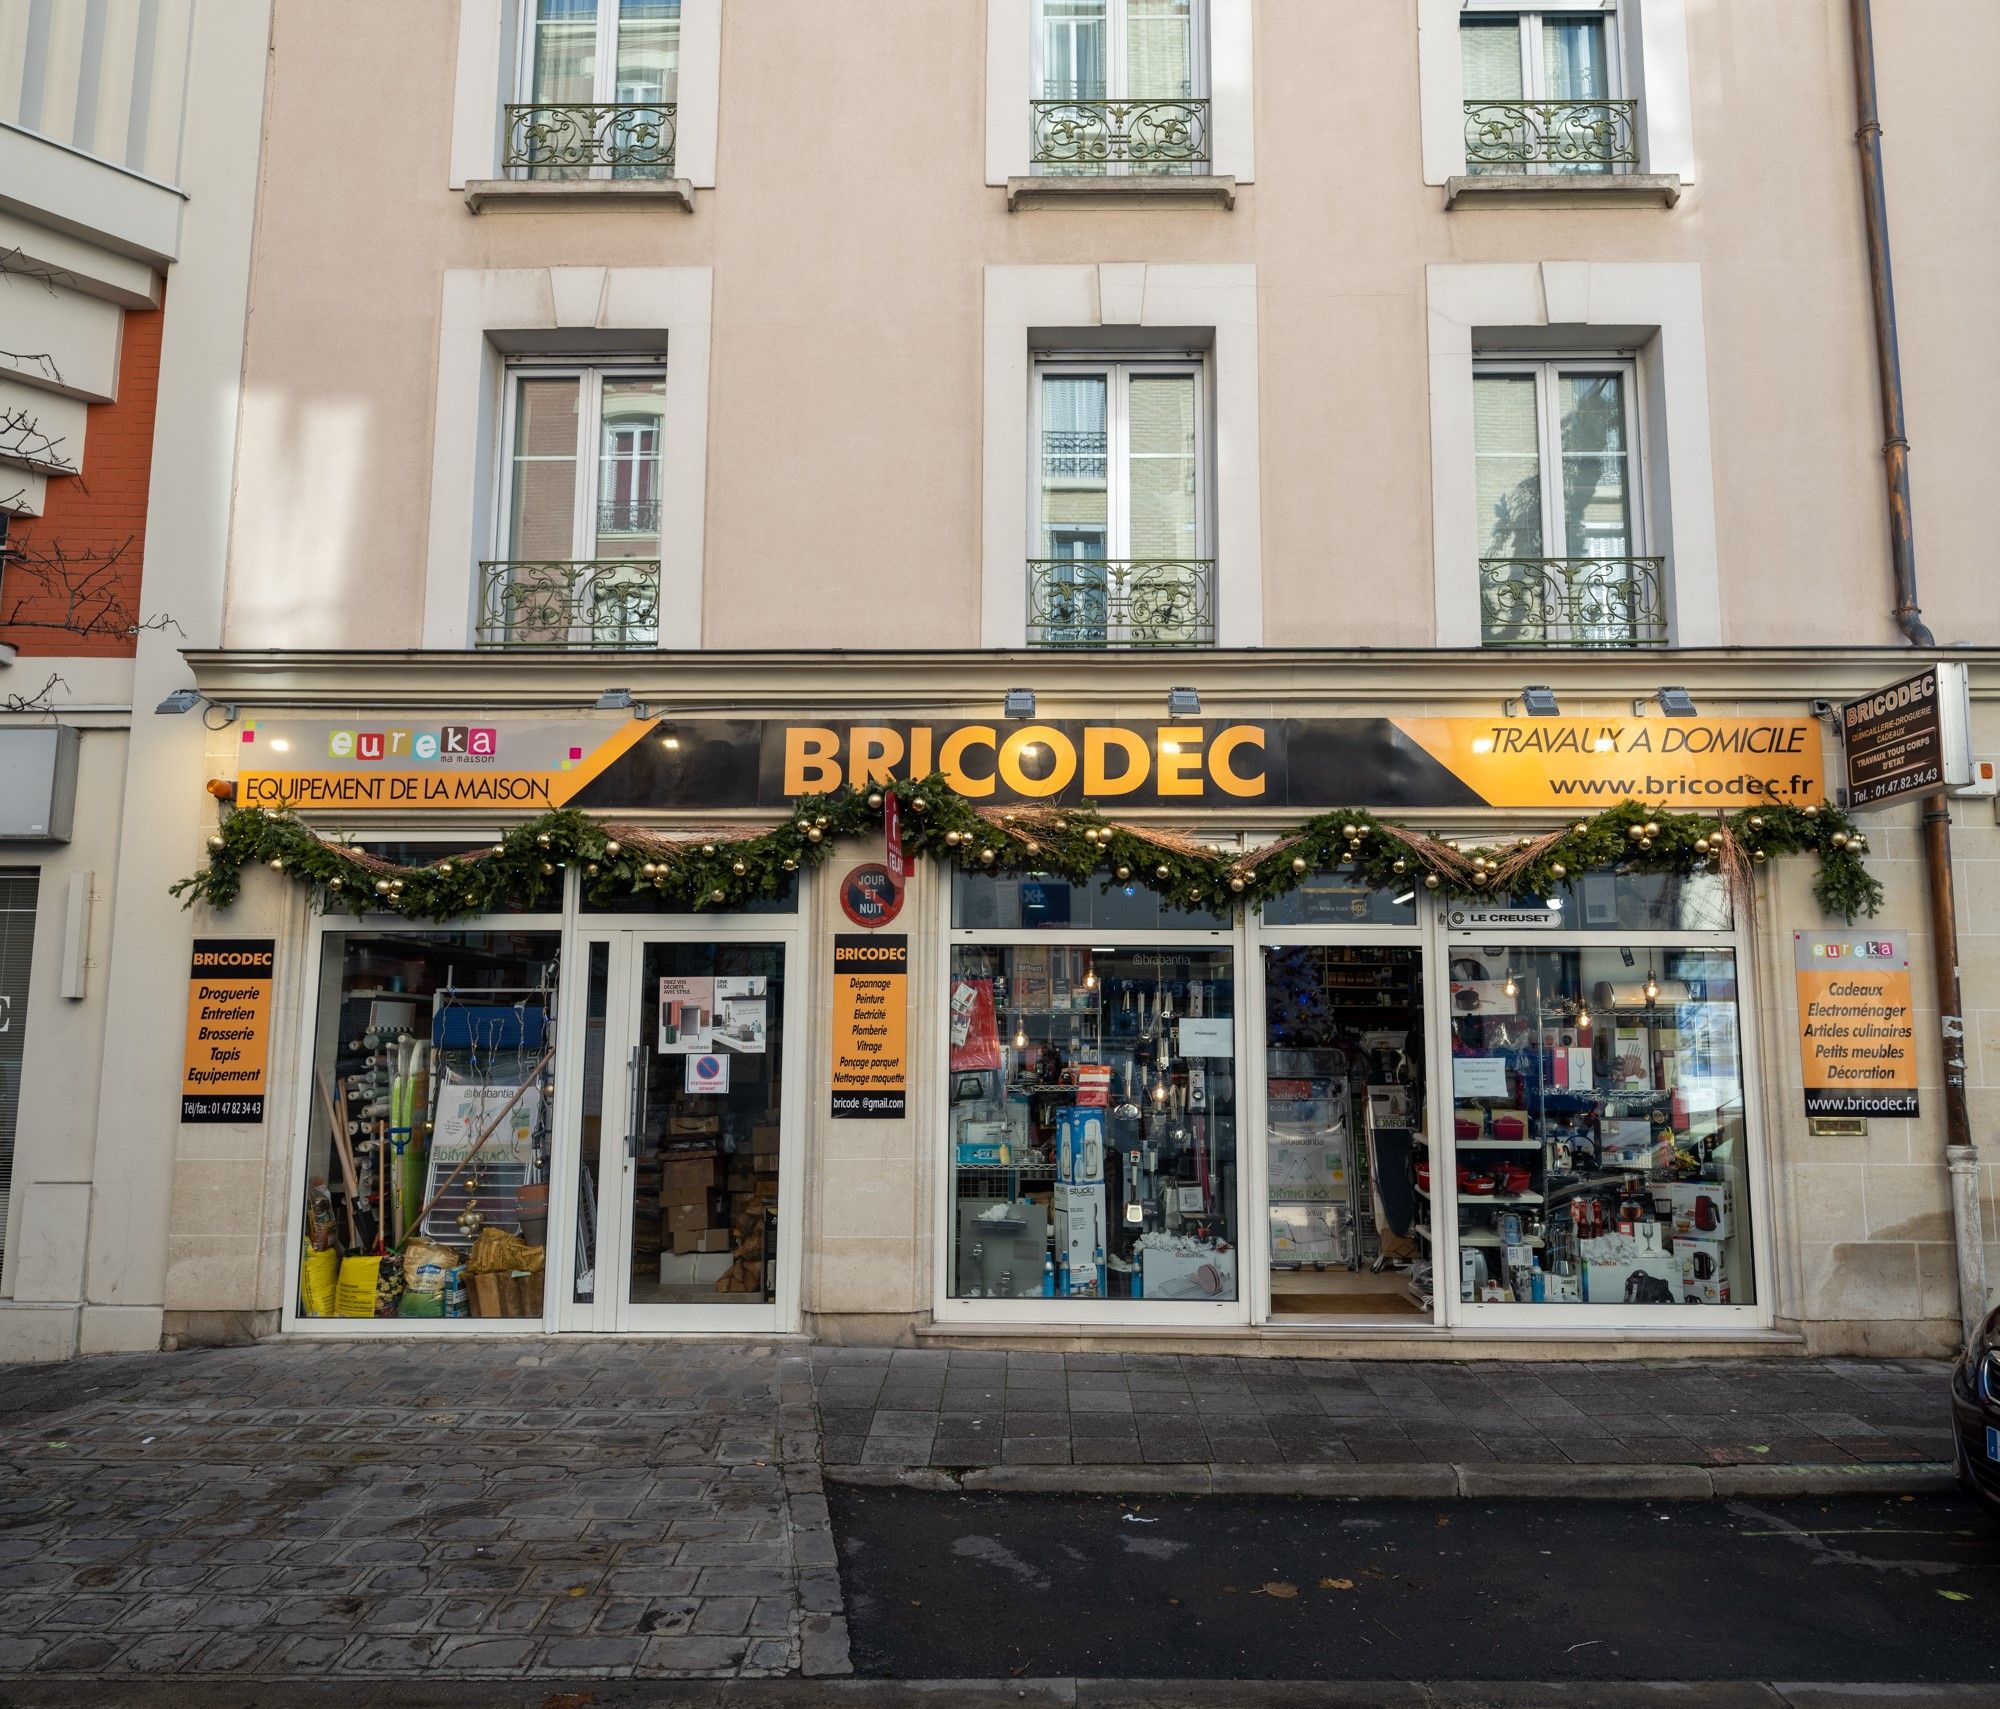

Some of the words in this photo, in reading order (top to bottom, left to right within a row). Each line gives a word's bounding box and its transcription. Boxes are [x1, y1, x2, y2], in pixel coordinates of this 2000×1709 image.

[1846, 675, 1935, 727] BRICODEC
[1490, 727, 1625, 753] TRAVAUX
[1627, 727, 1652, 753] A
[1661, 727, 1807, 753] DOMICILE
[1876, 727, 1905, 744] CADEAUX
[330, 727, 495, 760] eureka
[457, 755, 495, 763] maison
[1857, 753, 1887, 768] TRAVAUX
[1888, 745, 1906, 759] TOUS
[1907, 736, 1930, 751] CORPS
[783, 725, 1265, 797] BRICODEC
[1549, 775, 1814, 795] www.bricodec.fr
[1875, 767, 1938, 796] 01.47.82.34.43
[246, 778, 385, 800] EQUIPEMENT
[389, 778, 419, 800] DE
[424, 778, 454, 800] LA
[456, 778, 549, 800] MAISON
[858, 875, 885, 886] JOUR
[865, 889, 878, 899] ET
[859, 903, 883, 914] NUIT
[1470, 914, 1487, 922] LE
[1489, 914, 1550, 922] CREUSET
[836, 947, 906, 961] BRICODEC
[1813, 942, 1892, 957] eureka
[193, 952, 272, 966] BRICODEC
[1142, 953, 1191, 965] brabantia
[850, 977, 891, 991] Dépannage
[1829, 982, 1883, 996] Cadeaux
[198, 986, 260, 1003] Droguerie
[855, 993, 885, 1005] Peinture
[200, 1006, 255, 1020] Entretien
[853, 1008, 886, 1020] Electricité
[1808, 1002, 1906, 1020] Electroménager
[198, 1026, 254, 1040] Brosserie
[851, 1024, 888, 1036] Plomberie
[1804, 1023, 1849, 1038] Articles
[1852, 1023, 1912, 1038] culinaires
[856, 1040, 883, 1053] Vitrage
[1815, 1044, 1849, 1059] Petits
[1851, 1044, 1904, 1059] meubles
[210, 1047, 241, 1064] Tapis
[840, 1057, 869, 1070] Ponçage
[870, 1057, 900, 1070] parquet
[188, 1067, 261, 1084] Equipement
[833, 1072, 869, 1086] Nettoyage
[871, 1073, 905, 1086] moquette
[1828, 1065, 1895, 1080] Décoration
[472, 1088, 515, 1099] brabantia
[211, 1102, 220, 1114] 01
[221, 1102, 231, 1114] 47
[231, 1102, 241, 1114] 82
[241, 1102, 251, 1114] 34
[251, 1102, 261, 1114] 43
[1808, 1097, 1917, 1111] www.bricodec.fr
